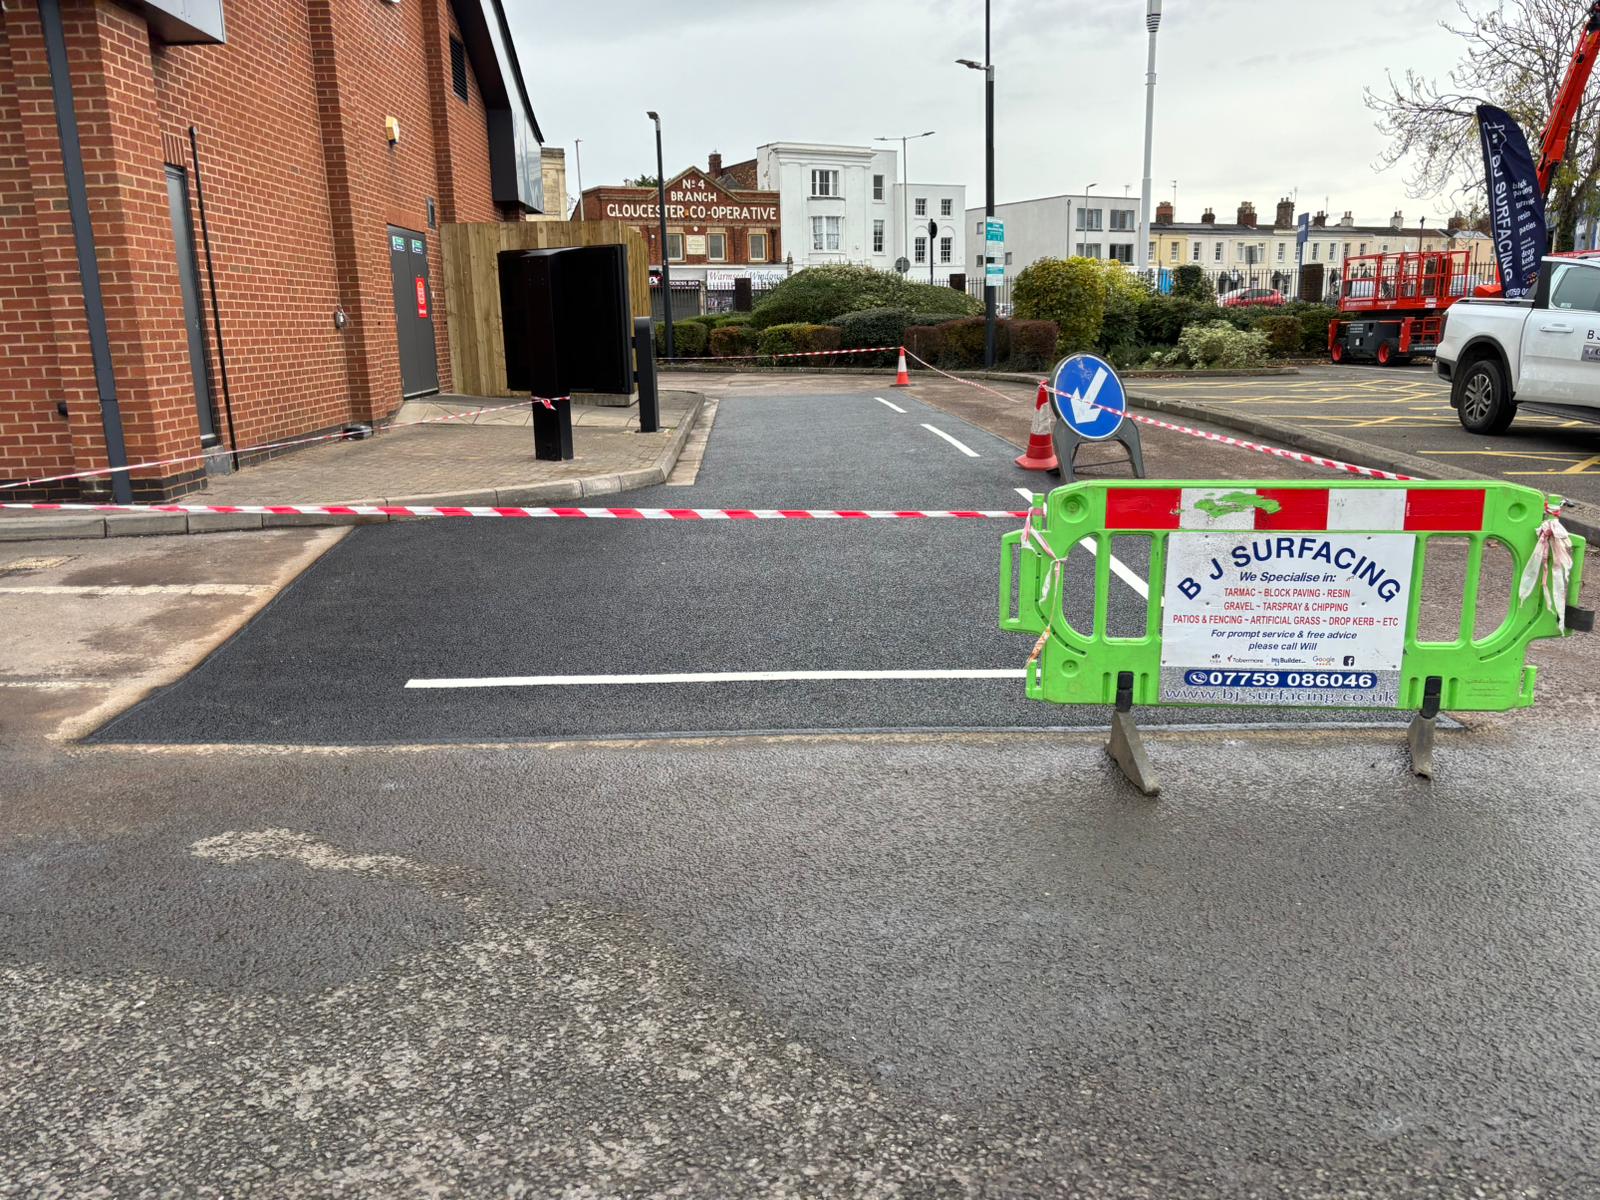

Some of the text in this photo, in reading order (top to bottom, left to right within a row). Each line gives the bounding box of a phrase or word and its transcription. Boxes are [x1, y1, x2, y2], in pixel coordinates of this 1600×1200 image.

[698, 179, 705, 190] 4
[670, 191, 717, 202] BRANCH
[606, 203, 777, 220] GLOUCESTER CO-OPERATIVE
[1517, 210, 1531, 222] resin
[1492, 154, 1513, 282] BJ SURFACING
[1519, 221, 1536, 235] patios
[1521, 247, 1535, 258] drop
[749, 270, 785, 281] Windows
[1587, 329, 1595, 340] B
[1177, 537, 1401, 603] B J SURFACING
[1239, 571, 1337, 583] We Specialise in:
[1224, 587, 1256, 597] TARMAC
[1264, 588, 1291, 597] BLOCK
[1292, 589, 1321, 598] PAVING
[1327, 589, 1351, 598] RESIN
[1223, 601, 1254, 610] GRAVEL
[1263, 602, 1302, 611] TARSPRAY
[1304, 603, 1310, 611] &
[1311, 603, 1349, 612] CHIPPING
[1173, 614, 1200, 624] PATIOS
[1202, 615, 1207, 624] &
[1209, 615, 1243, 624] FENCING
[1250, 615, 1291, 625] ARTIFICIAL
[1293, 616, 1321, 625] GRASS
[1329, 617, 1351, 626] DROP
[1352, 617, 1375, 626] KERB
[1382, 617, 1399, 626] ETC
[1211, 629, 1358, 639] For prompt service & free advice
[1248, 641, 1318, 651] please call Will
[1312, 655, 1336, 663] Google
[1209, 672, 1373, 687] 07759 086046
